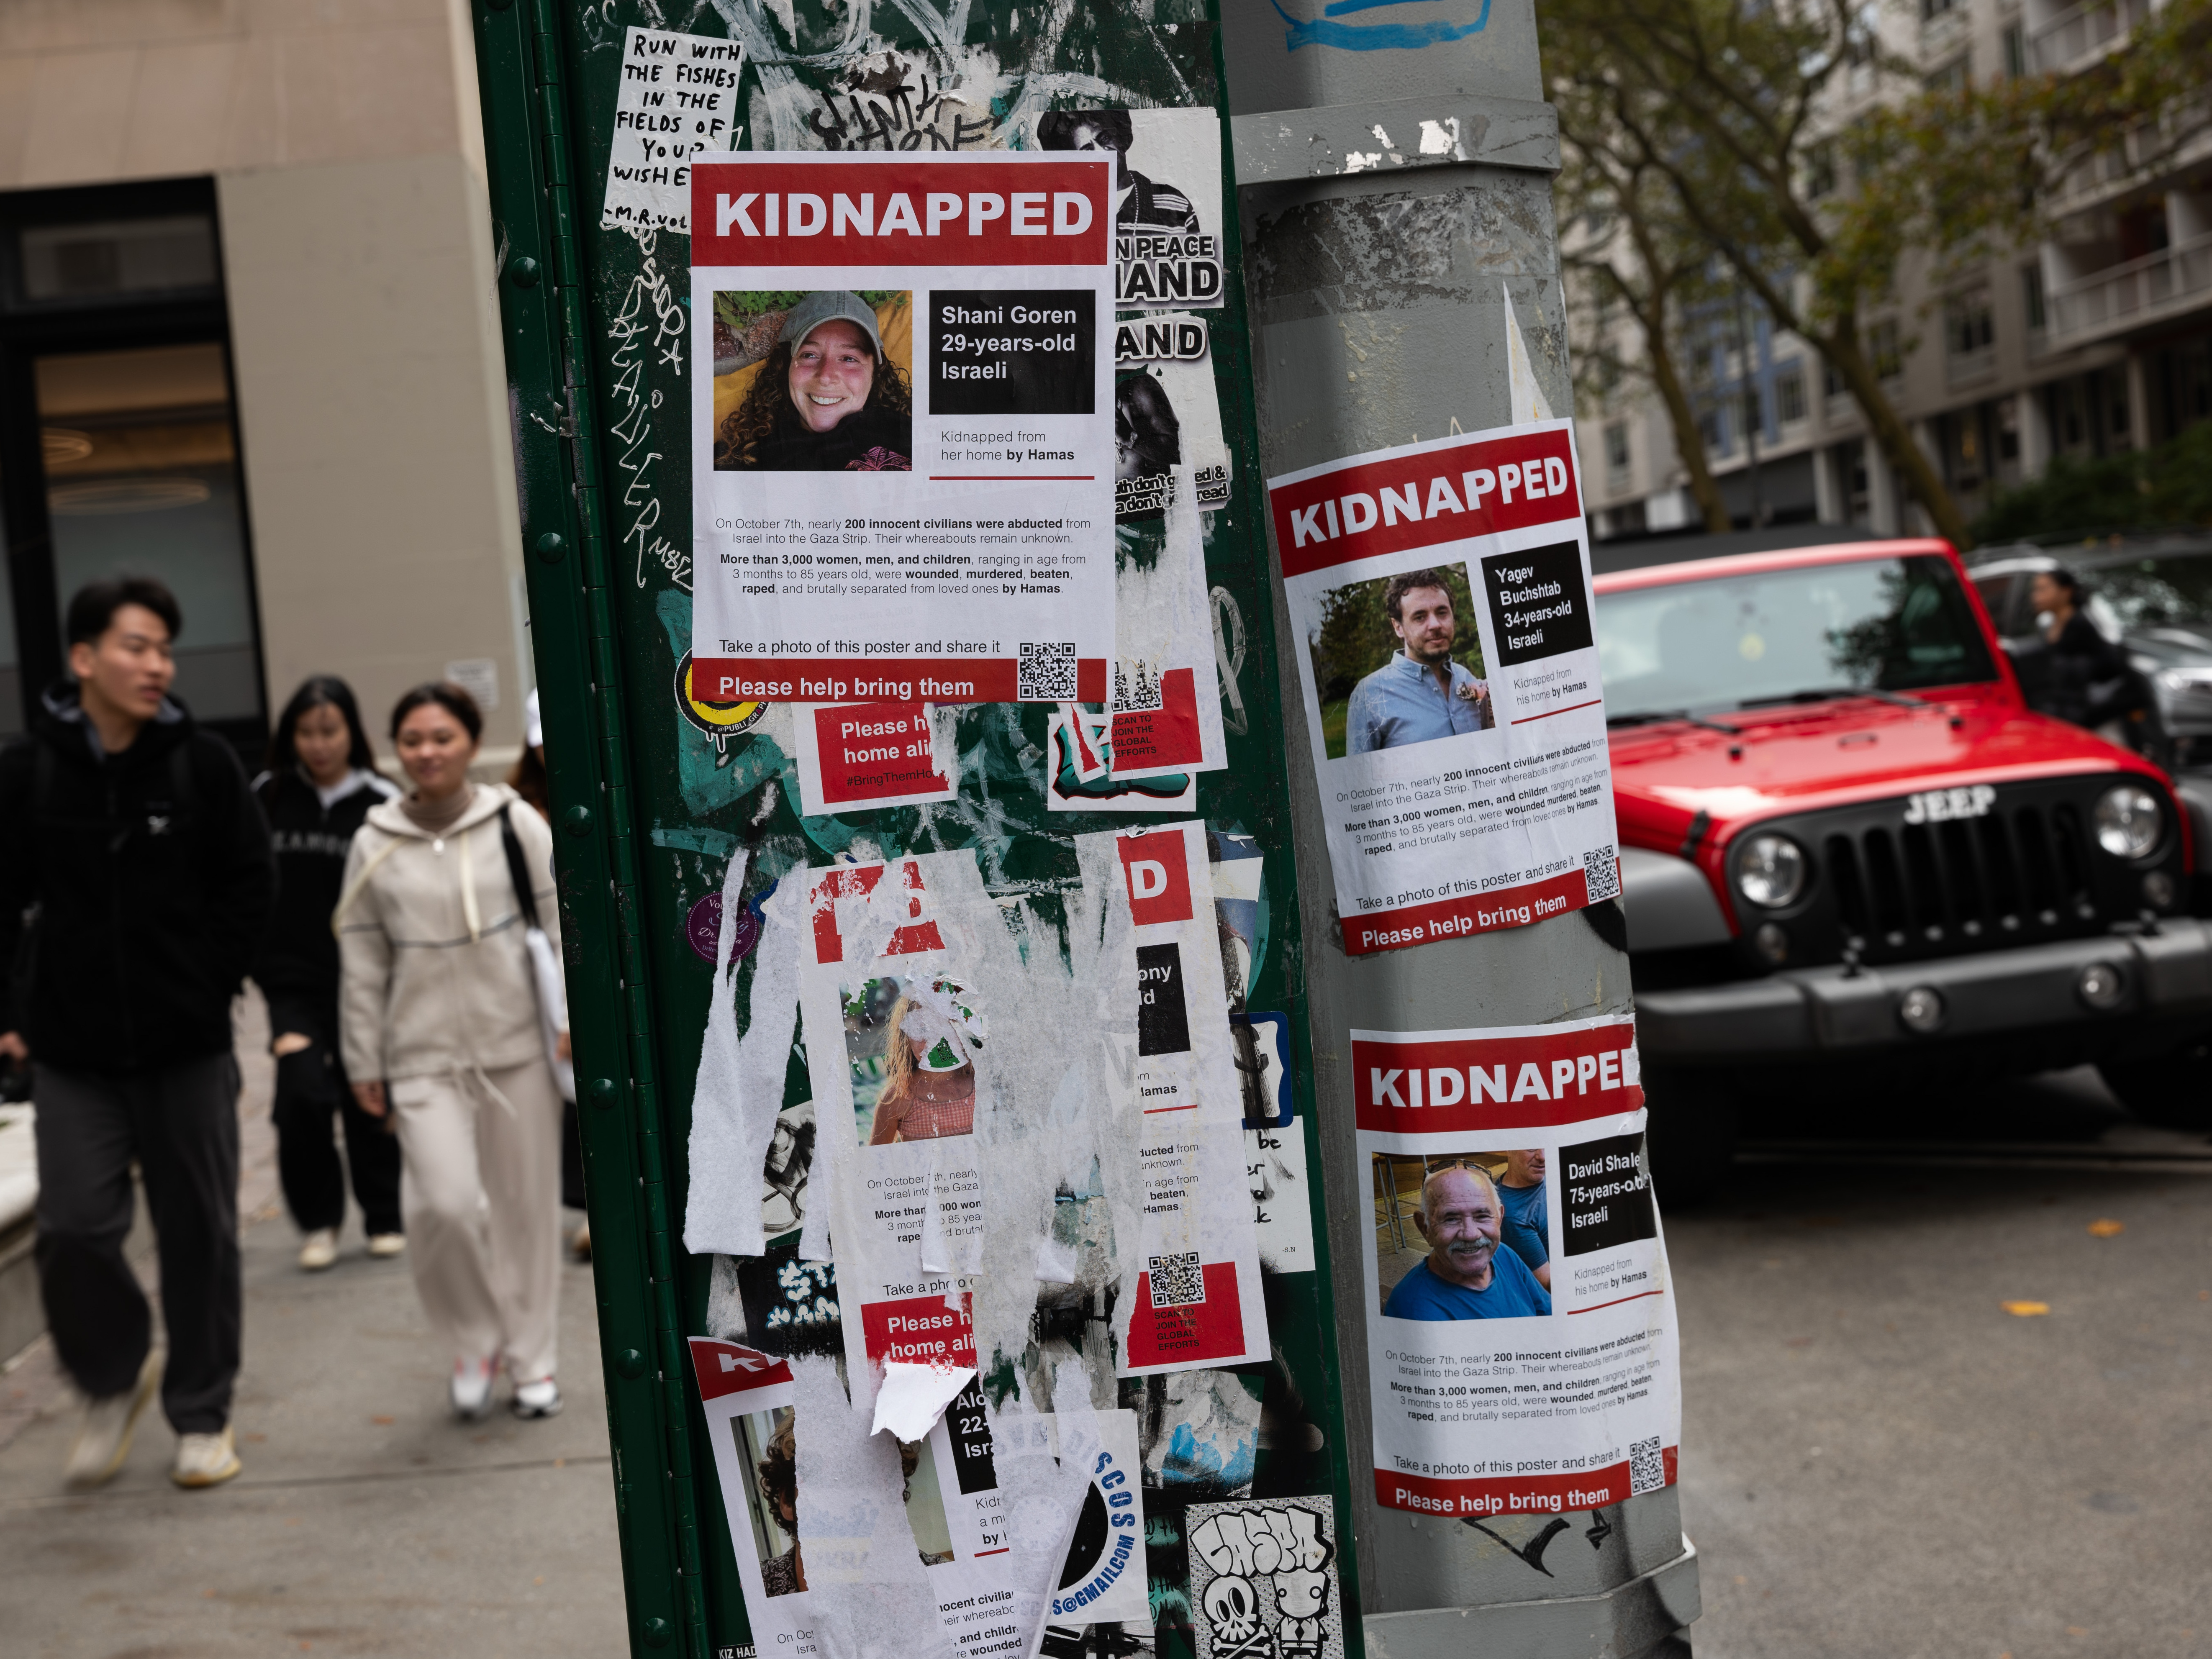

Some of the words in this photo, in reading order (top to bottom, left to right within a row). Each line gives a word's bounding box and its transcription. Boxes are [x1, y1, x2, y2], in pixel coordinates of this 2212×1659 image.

[634, 35, 676, 57] RUN
[692, 43, 741, 61] WITH
[625, 64, 664, 82] THE
[676, 64, 736, 88] FISHES
[643, 92, 665, 107] IN
[677, 91, 721, 110] THE
[617, 111, 682, 133] FIELDS
[716, 192, 1093, 236] KIDNAPPED
[1136, 236, 1214, 258] PEACE
[942, 306, 1003, 324] Shani
[1011, 306, 1076, 324] Goren
[942, 333, 1075, 356] 29-years-old
[942, 361, 1006, 379] Israeli
[942, 431, 1012, 444] Kidnapped
[1018, 431, 1045, 442] from
[942, 449, 962, 460] her
[967, 449, 1002, 460] home
[1007, 449, 1023, 462] by
[1028, 449, 1074, 460] Hamas
[1291, 456, 1568, 548] KIDNAPPED
[716, 518, 731, 528] On
[736, 518, 780, 529] October
[784, 519, 803, 530] 7th,
[808, 519, 842, 531] nearly
[845, 519, 865, 529] 200
[869, 519, 920, 529] innocent
[924, 518, 973, 528] civilians
[1008, 518, 1062, 528] abducted
[1066, 518, 1090, 528] from
[733, 533, 762, 544] Israel
[766, 533, 785, 544] into
[789, 533, 806, 544] the
[810, 533, 839, 544] Gaza
[843, 533, 870, 546] Strip.
[875, 533, 902, 543] Their
[905, 533, 976, 543] whereabouts
[980, 533, 1017, 543] remain
[1021, 533, 1073, 543] unknown.
[721, 554, 749, 564] More
[752, 554, 778, 564] than
[782, 554, 813, 566] 3,000
[816, 556, 861, 566] women,
[866, 556, 894, 566] men,
[898, 554, 919, 564] and
[923, 554, 973, 565] children,
[978, 554, 1020, 567] ranging
[1024, 554, 1033, 564] in
[1037, 556, 1058, 567] age
[1062, 554, 1085, 564] from
[733, 569, 739, 578] 3
[744, 569, 783, 579] months
[786, 569, 797, 579] to
[801, 569, 814, 579] 85
[818, 571, 847, 581] years
[851, 569, 871, 580] old,
[905, 569, 962, 580] wounded,
[966, 569, 1026, 580] murdered,
[1030, 569, 1072, 580] beaten,
[1495, 566, 1533, 584] Yagev
[742, 583, 778, 595] raped,
[782, 584, 803, 593] and
[807, 584, 847, 596] brutally
[851, 584, 906, 596] separated
[911, 583, 934, 593] from
[939, 584, 968, 593] loved
[1003, 583, 1016, 596] by
[1021, 583, 1063, 593] Hamas.
[1500, 580, 1561, 606] Buchshtab
[1504, 600, 1572, 628] 34-years-old
[719, 639, 753, 653] Take
[758, 643, 767, 653] a
[772, 640, 811, 656] photo
[816, 640, 830, 653] of
[834, 640, 860, 653] this
[865, 641, 910, 656] poster
[915, 640, 941, 653] and
[947, 640, 987, 653] share
[993, 640, 1000, 653] it
[1508, 629, 1544, 650] Israeli
[720, 677, 792, 695] Please
[801, 677, 847, 700] help
[855, 677, 911, 700] bring
[919, 677, 974, 696] them
[1514, 673, 1555, 689] Kidnapped
[1556, 669, 1572, 681] from
[1517, 695, 1529, 705] his
[1531, 690, 1550, 703] home
[1552, 687, 1560, 699] by
[1563, 681, 1587, 694] Hamas
[841, 719, 908, 739] Please
[1112, 716, 1137, 726] SCAN
[1113, 727, 1134, 736] JOIN
[1135, 725, 1154, 733] THE
[1114, 736, 1152, 747] GLOBAL
[843, 743, 901, 764] home
[1115, 746, 1157, 758] EFFORTS
[1904, 784, 1996, 825] JEEP
[1356, 896, 1383, 910] Take
[1386, 896, 1395, 906] a
[1398, 888, 1434, 906] photo
[1438, 882, 1451, 896] of
[1453, 879, 1478, 893] this
[1481, 871, 1522, 888] poster
[1525, 864, 1544, 879] and
[1545, 858, 1568, 874] share
[1569, 855, 1575, 867] it
[1362, 926, 1424, 947] Please
[1429, 915, 1473, 936] help
[1478, 905, 1530, 927] bring
[1534, 895, 1566, 916] them
[1569, 1157, 1603, 1180] David
[1572, 1206, 1608, 1228] Israeli
[1574, 1262, 1614, 1280] Kidnapped
[1617, 1258, 1632, 1270] from
[1575, 1285, 1587, 1296] his
[1589, 1280, 1609, 1293] home
[1611, 1277, 1619, 1288] by
[1622, 1271, 1647, 1285] Hamas
[888, 1314, 953, 1333] Please
[1155, 1310, 1180, 1320] SCAN
[1156, 1321, 1176, 1330] JOIN
[1178, 1318, 1197, 1327] THE
[1157, 1330, 1195, 1341] GLOBAL
[1158, 1339, 1200, 1351] EFFORTS
[890, 1341, 946, 1358] home
[1395, 1487, 1454, 1512] Please
[1460, 1495, 1504, 1514] help
[1509, 1492, 1562, 1512] bring
[1567, 1487, 1609, 1507] them
